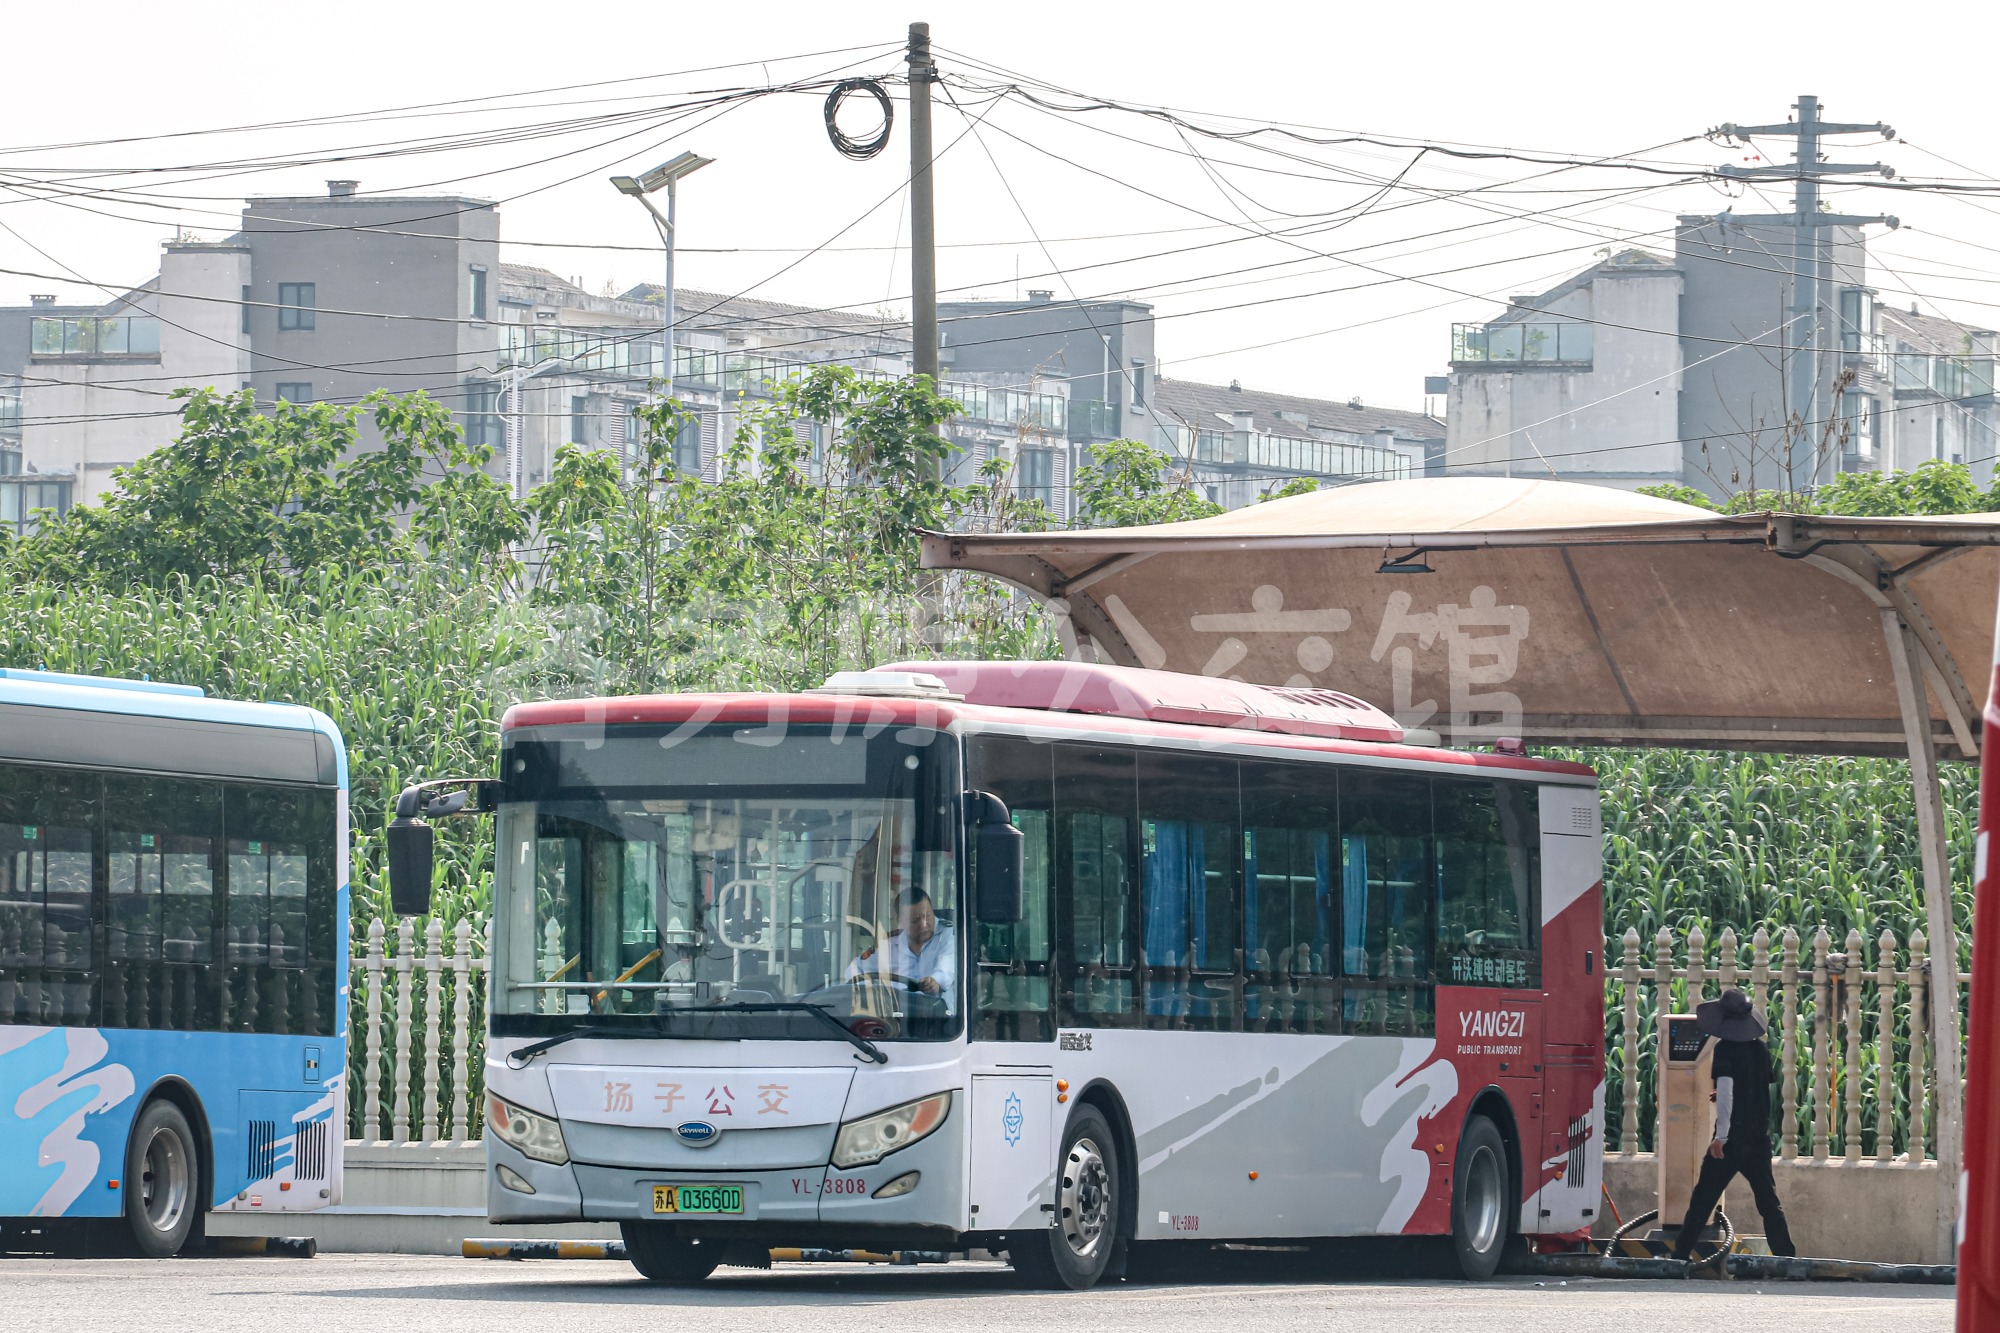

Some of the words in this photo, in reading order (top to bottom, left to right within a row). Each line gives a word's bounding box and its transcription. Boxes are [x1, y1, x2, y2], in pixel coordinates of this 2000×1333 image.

[1460, 1010, 1525, 1037] YANGZI
[1457, 1045, 1481, 1054] PUBLIC
[1483, 1046, 1522, 1055] TRANSPORT
[604, 1081, 788, 1116] 扬子公交
[792, 1178, 866, 1194] YL-3808
[1172, 1215, 1199, 1231] YL-3808
